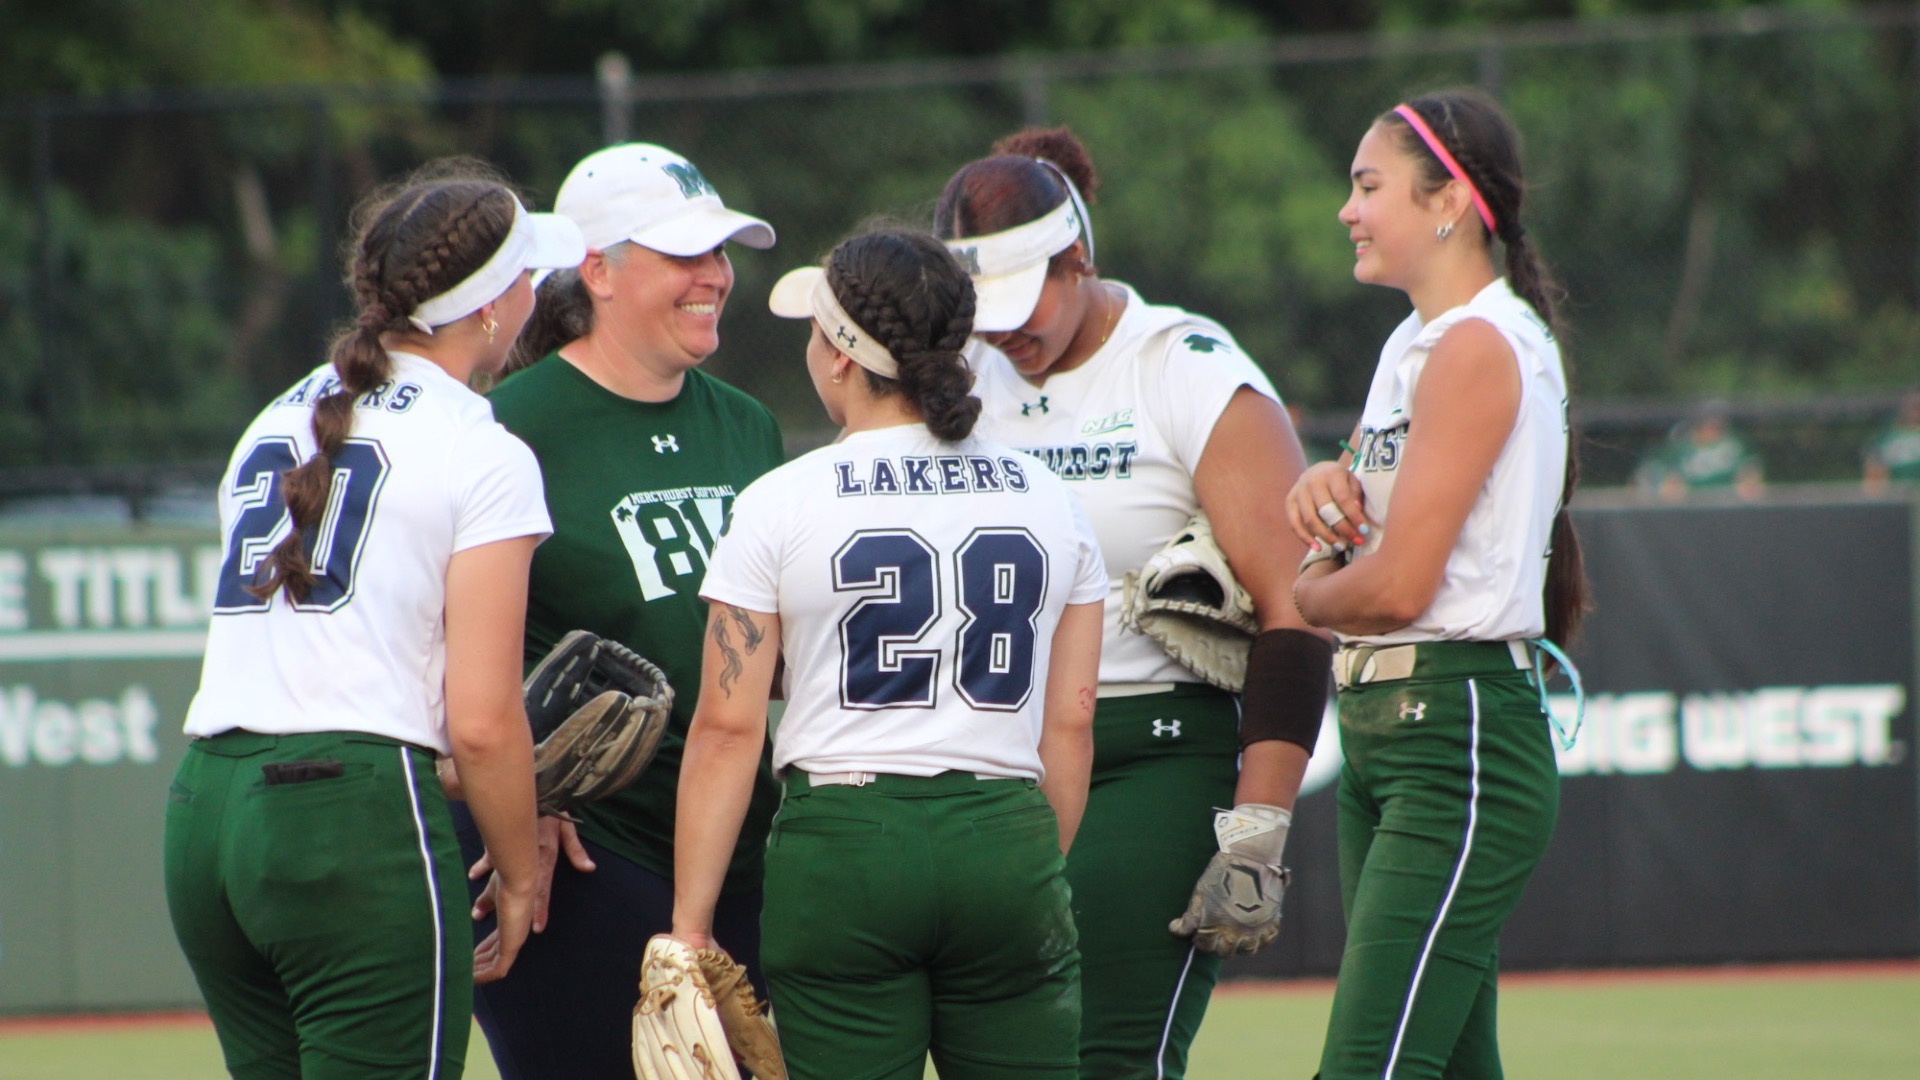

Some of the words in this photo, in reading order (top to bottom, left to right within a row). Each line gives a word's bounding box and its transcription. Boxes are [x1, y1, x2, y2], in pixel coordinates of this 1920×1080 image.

[661, 163, 719, 199] M
[835, 455, 1029, 498] LAKERS
[1023, 440, 1138, 481] URST
[629, 486, 694, 505] MERCYHURST
[693, 484, 737, 499] SOFTBALL
[213, 436, 392, 616] 20
[831, 526, 1049, 713] 28
[1682, 684, 1906, 769] WEST
